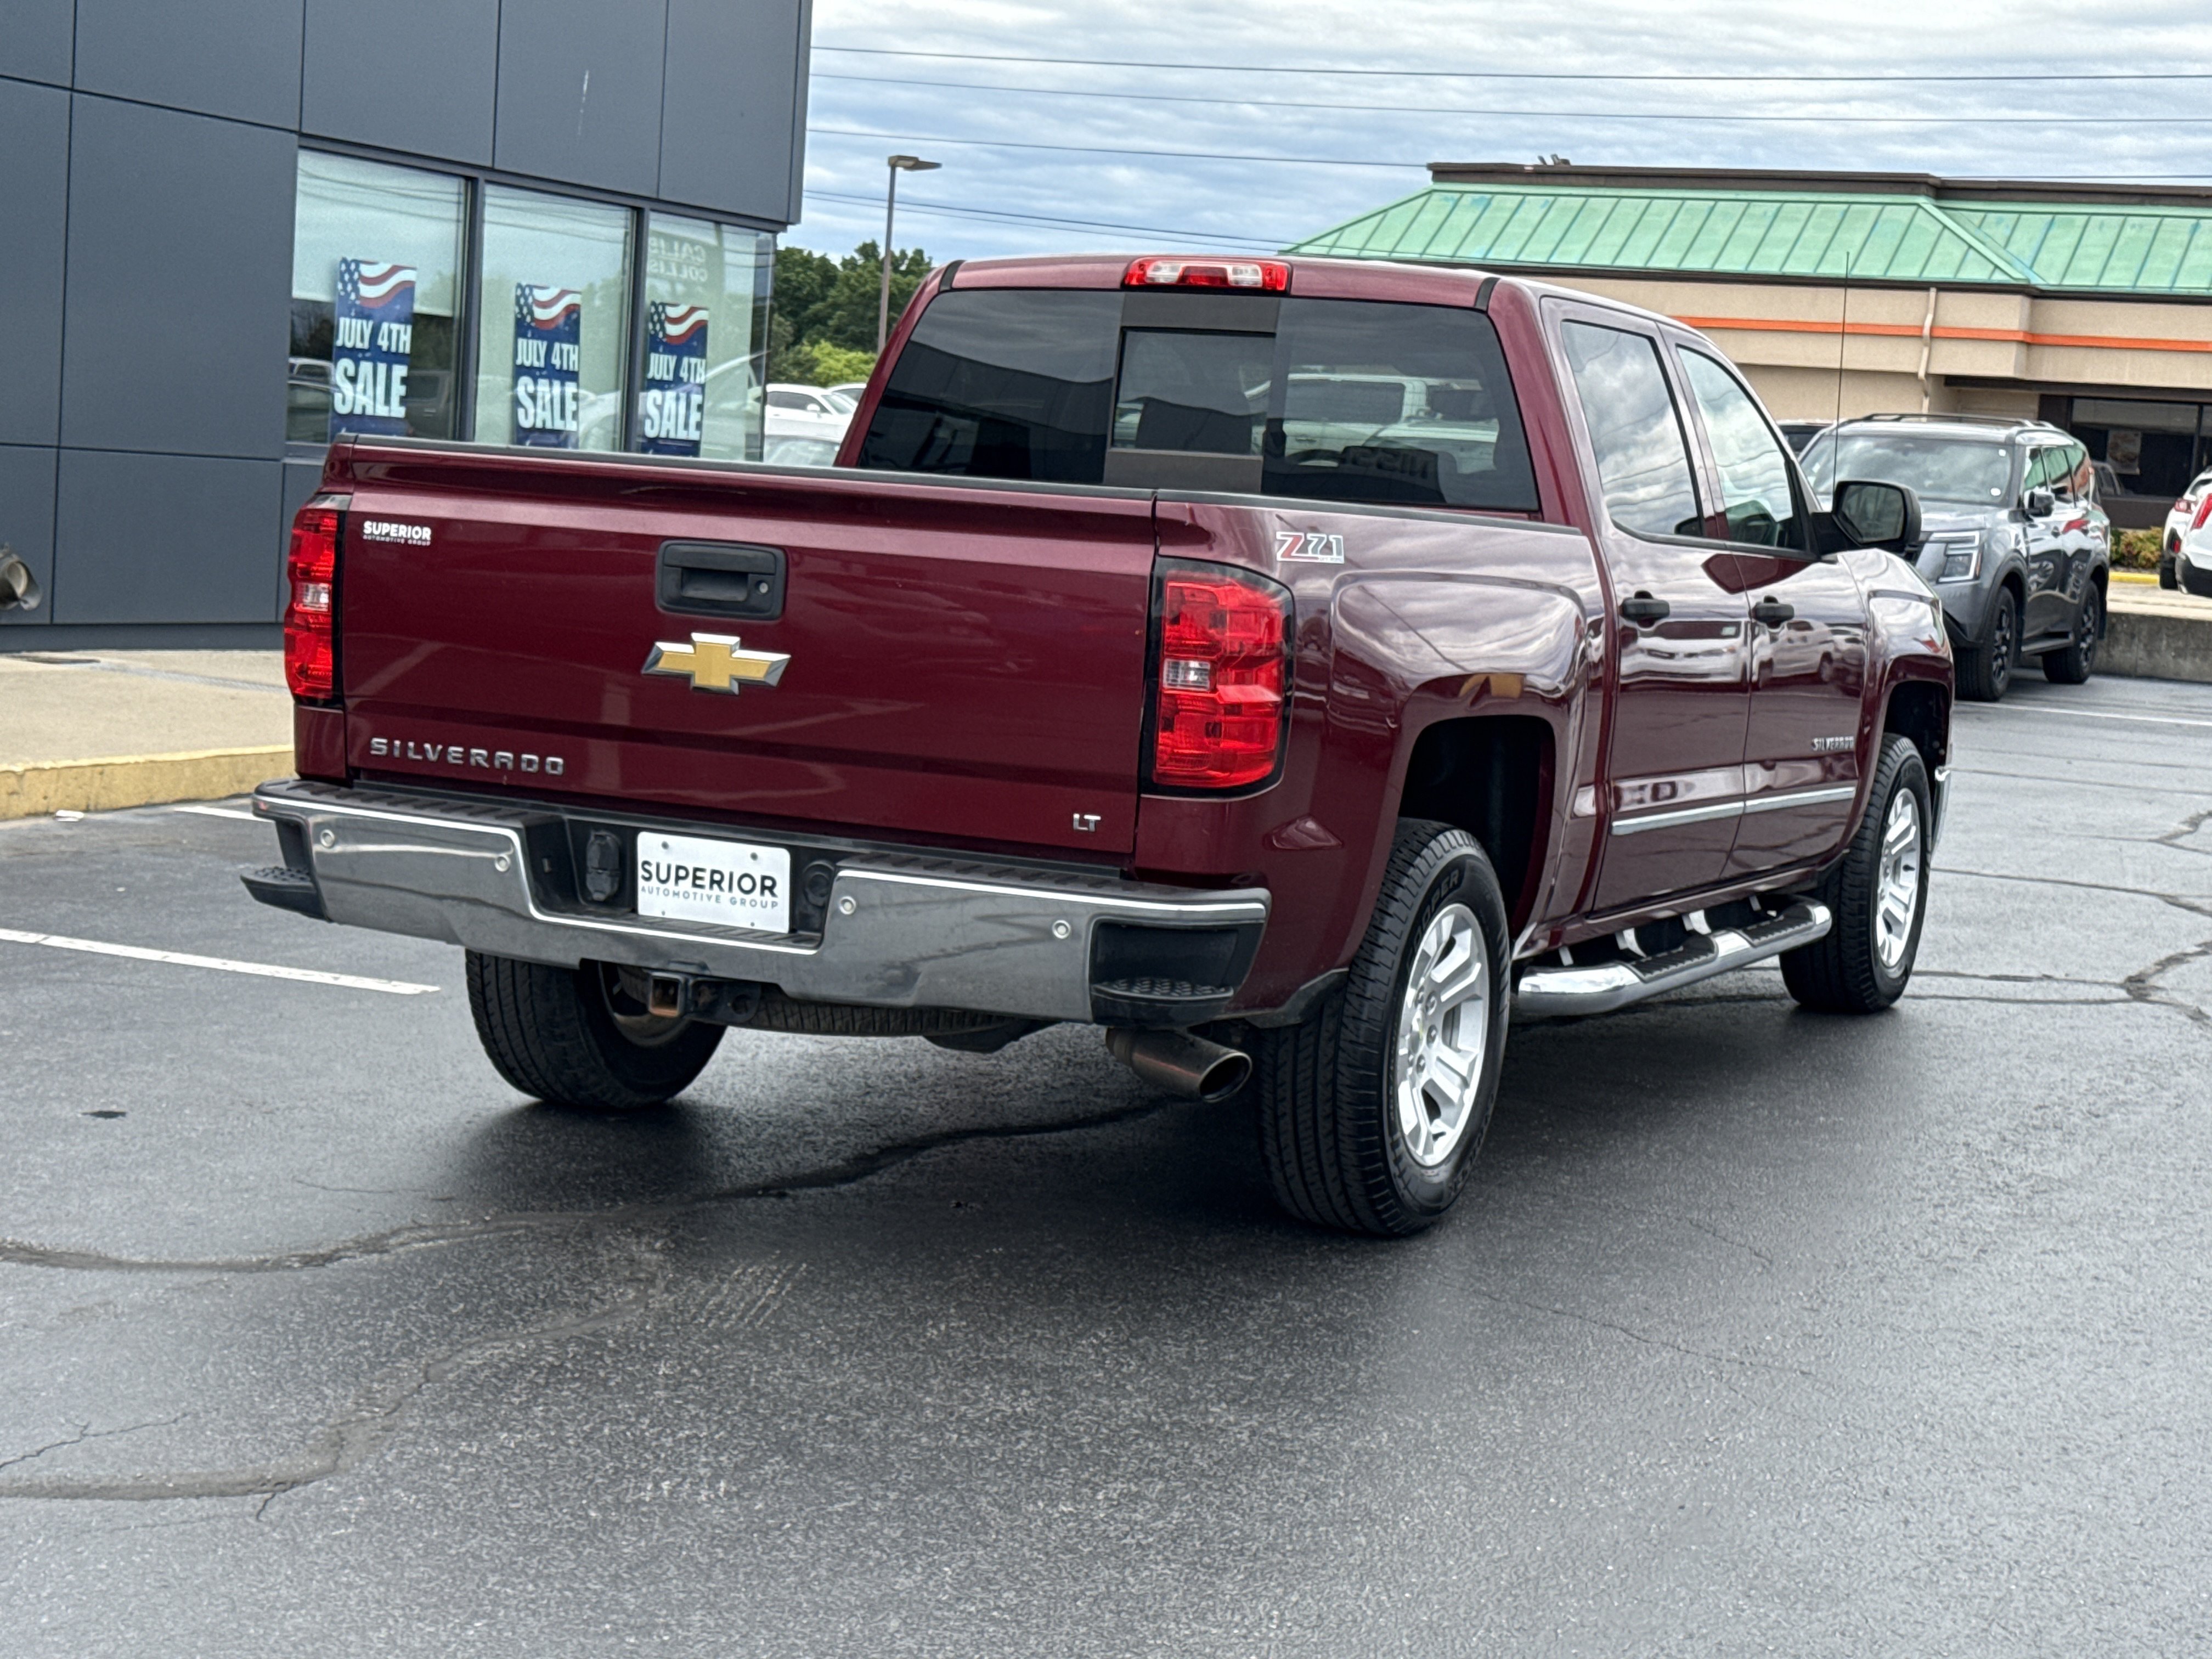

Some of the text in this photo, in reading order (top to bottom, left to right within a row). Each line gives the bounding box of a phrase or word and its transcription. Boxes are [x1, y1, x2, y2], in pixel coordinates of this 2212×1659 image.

[336, 317, 412, 354] JULY 4TH
[516, 337, 579, 371] JULY 4TH
[647, 352, 706, 384] JULY 4TH
[334, 358, 408, 418] SALE
[517, 376, 578, 432] SALE
[645, 389, 702, 441] SALE
[363, 521, 431, 540] SUPERIOR
[1276, 532, 1345, 564] Z71
[370, 737, 564, 776] SILVERADO
[1073, 810, 1102, 832] LT
[641, 860, 778, 898] SUPERIOR
[641, 885, 778, 909] AUTOMOTIVE GROUP
